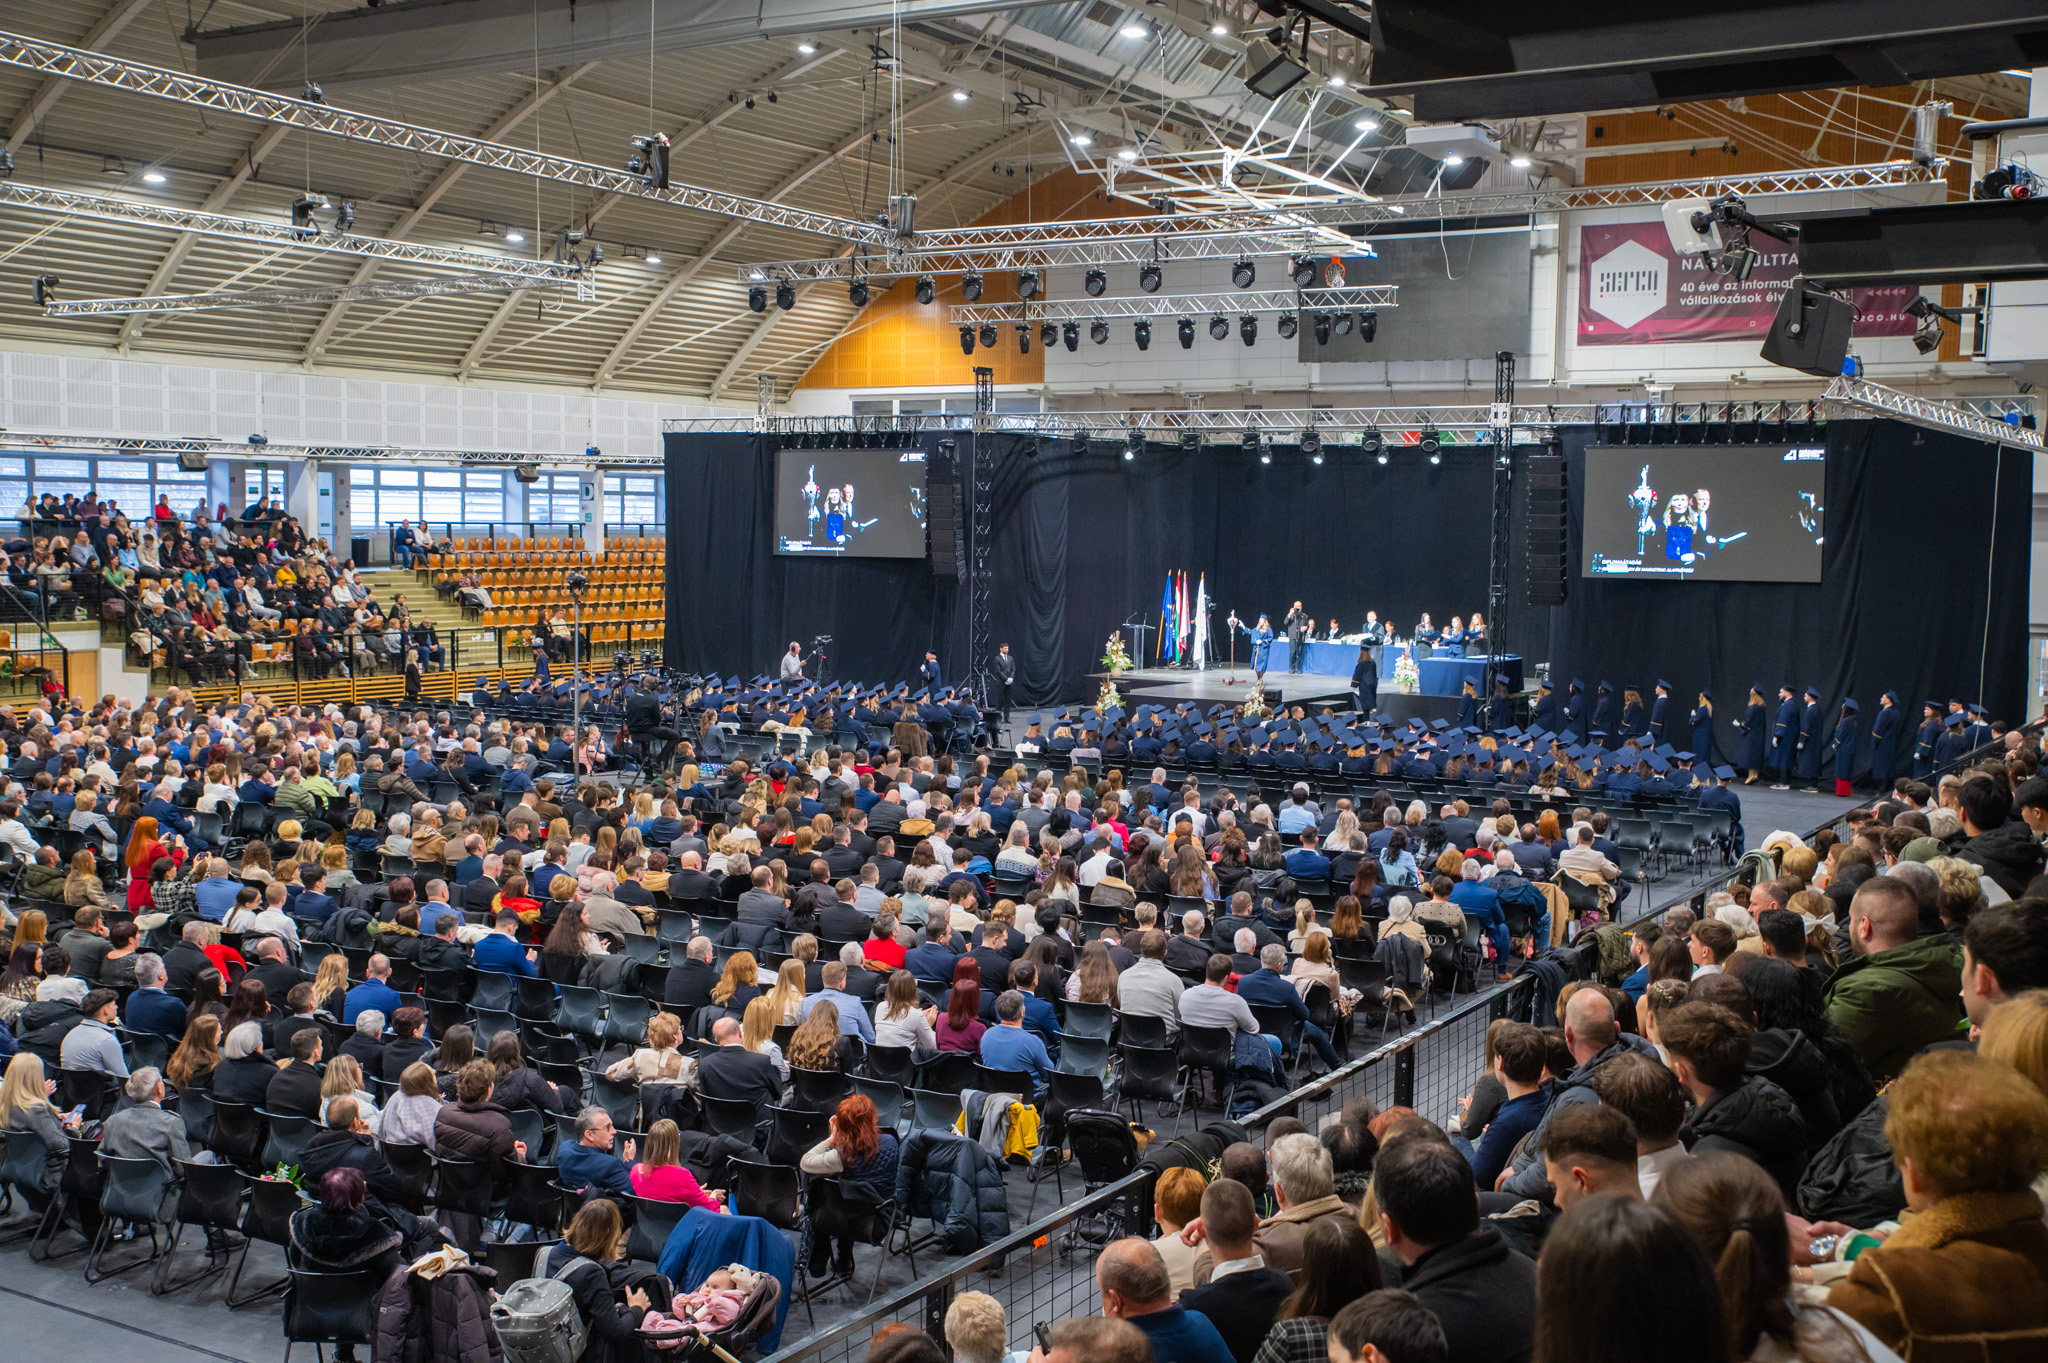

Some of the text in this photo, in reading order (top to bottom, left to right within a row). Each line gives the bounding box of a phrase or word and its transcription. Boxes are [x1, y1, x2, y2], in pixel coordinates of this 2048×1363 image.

[1680, 282, 1695, 293] 40
[1698, 281, 1720, 291] éve
[1724, 282, 1738, 291] az
[1680, 292, 1762, 305] vállalkozások
[581, 483, 594, 500] D
